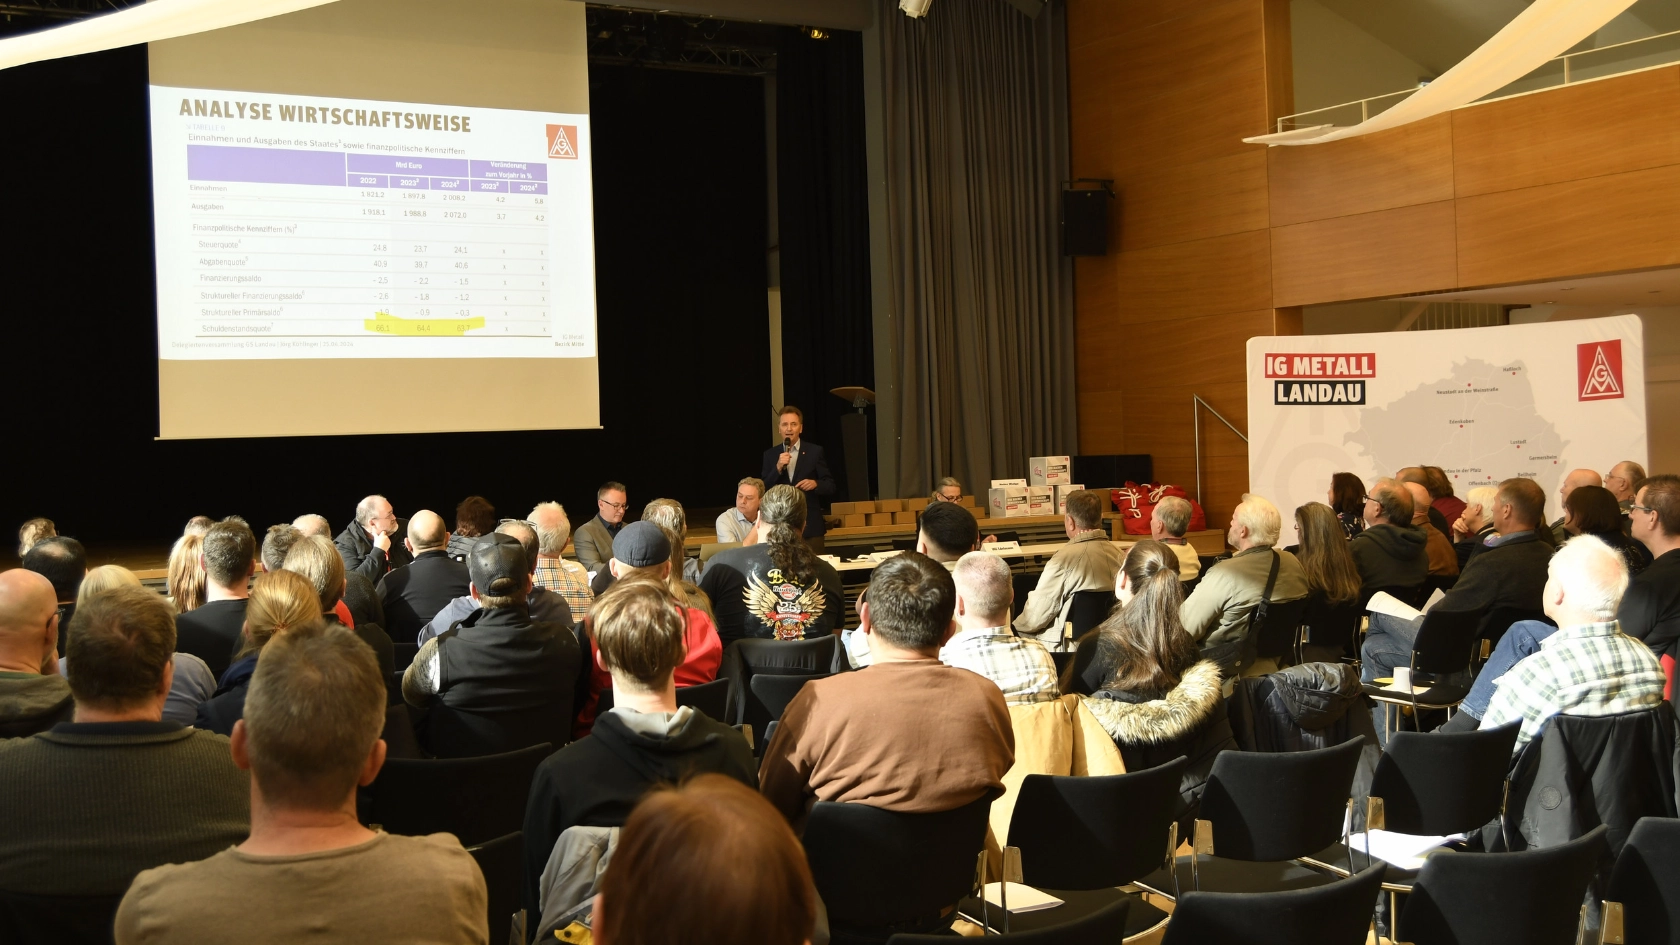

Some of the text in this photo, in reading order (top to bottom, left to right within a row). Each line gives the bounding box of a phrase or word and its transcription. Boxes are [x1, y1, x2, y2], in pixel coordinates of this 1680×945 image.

[179, 99, 472, 133] ANALYSE WIRTSCHAFTSWEISE
[188, 133, 234, 143] Einnahmen
[254, 136, 292, 147] Ausgaben
[294, 138, 307, 147] des
[366, 142, 423, 153] finanzpolitische
[424, 145, 465, 155] Kennziffern
[490, 161, 526, 170] Veränderung
[192, 224, 245, 232] Finanzpolitische
[200, 274, 262, 283] Finanzierungssaldo
[1267, 356, 1373, 375] IG METALL
[1278, 384, 1361, 402] LANDAU
[781, 602, 797, 612] 25
